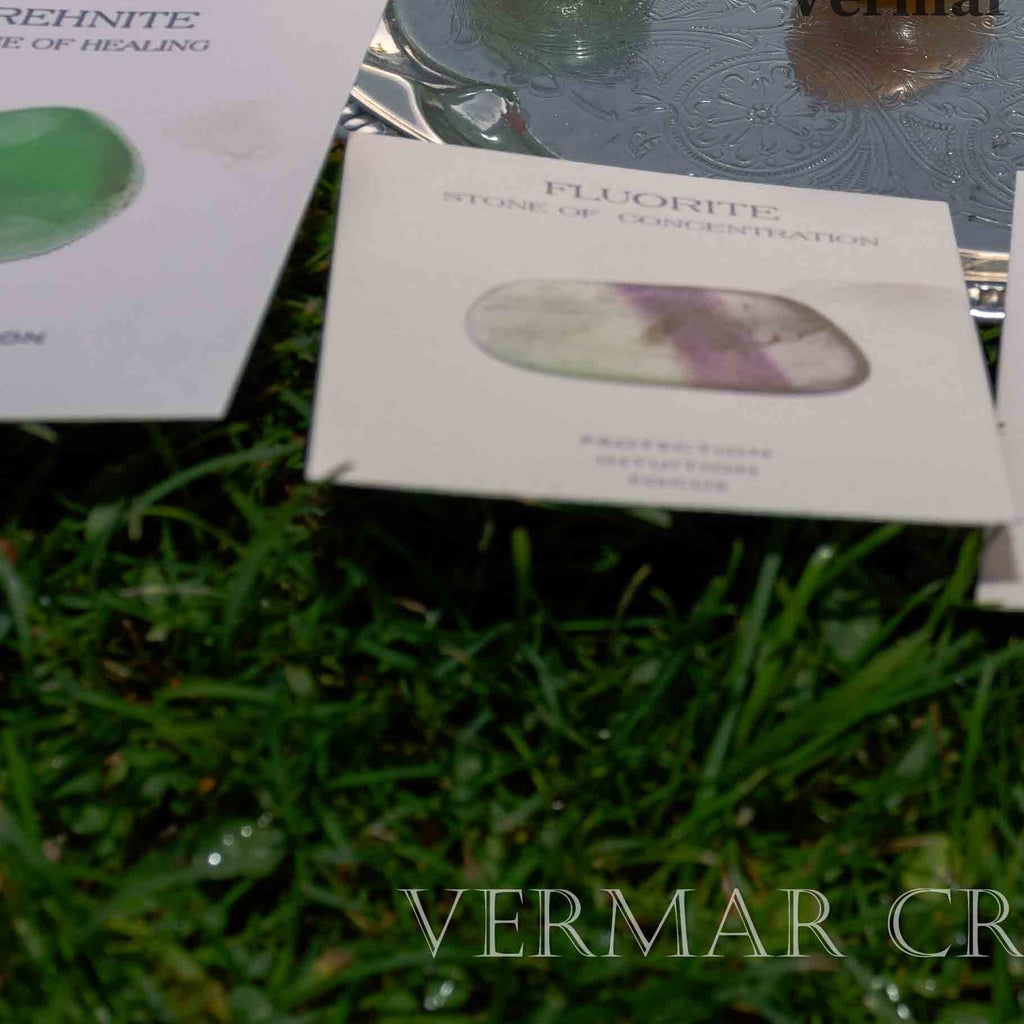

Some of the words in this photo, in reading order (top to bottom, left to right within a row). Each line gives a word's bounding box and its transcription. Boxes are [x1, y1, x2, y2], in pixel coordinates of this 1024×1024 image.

[32, 37, 76, 51] OF
[80, 39, 210, 53] HEALING
[442, 191, 548, 213] STONE
[557, 205, 602, 219] OF
[617, 212, 880, 247] CONCENTRATION
[545, 181, 781, 221] FLUORITE
